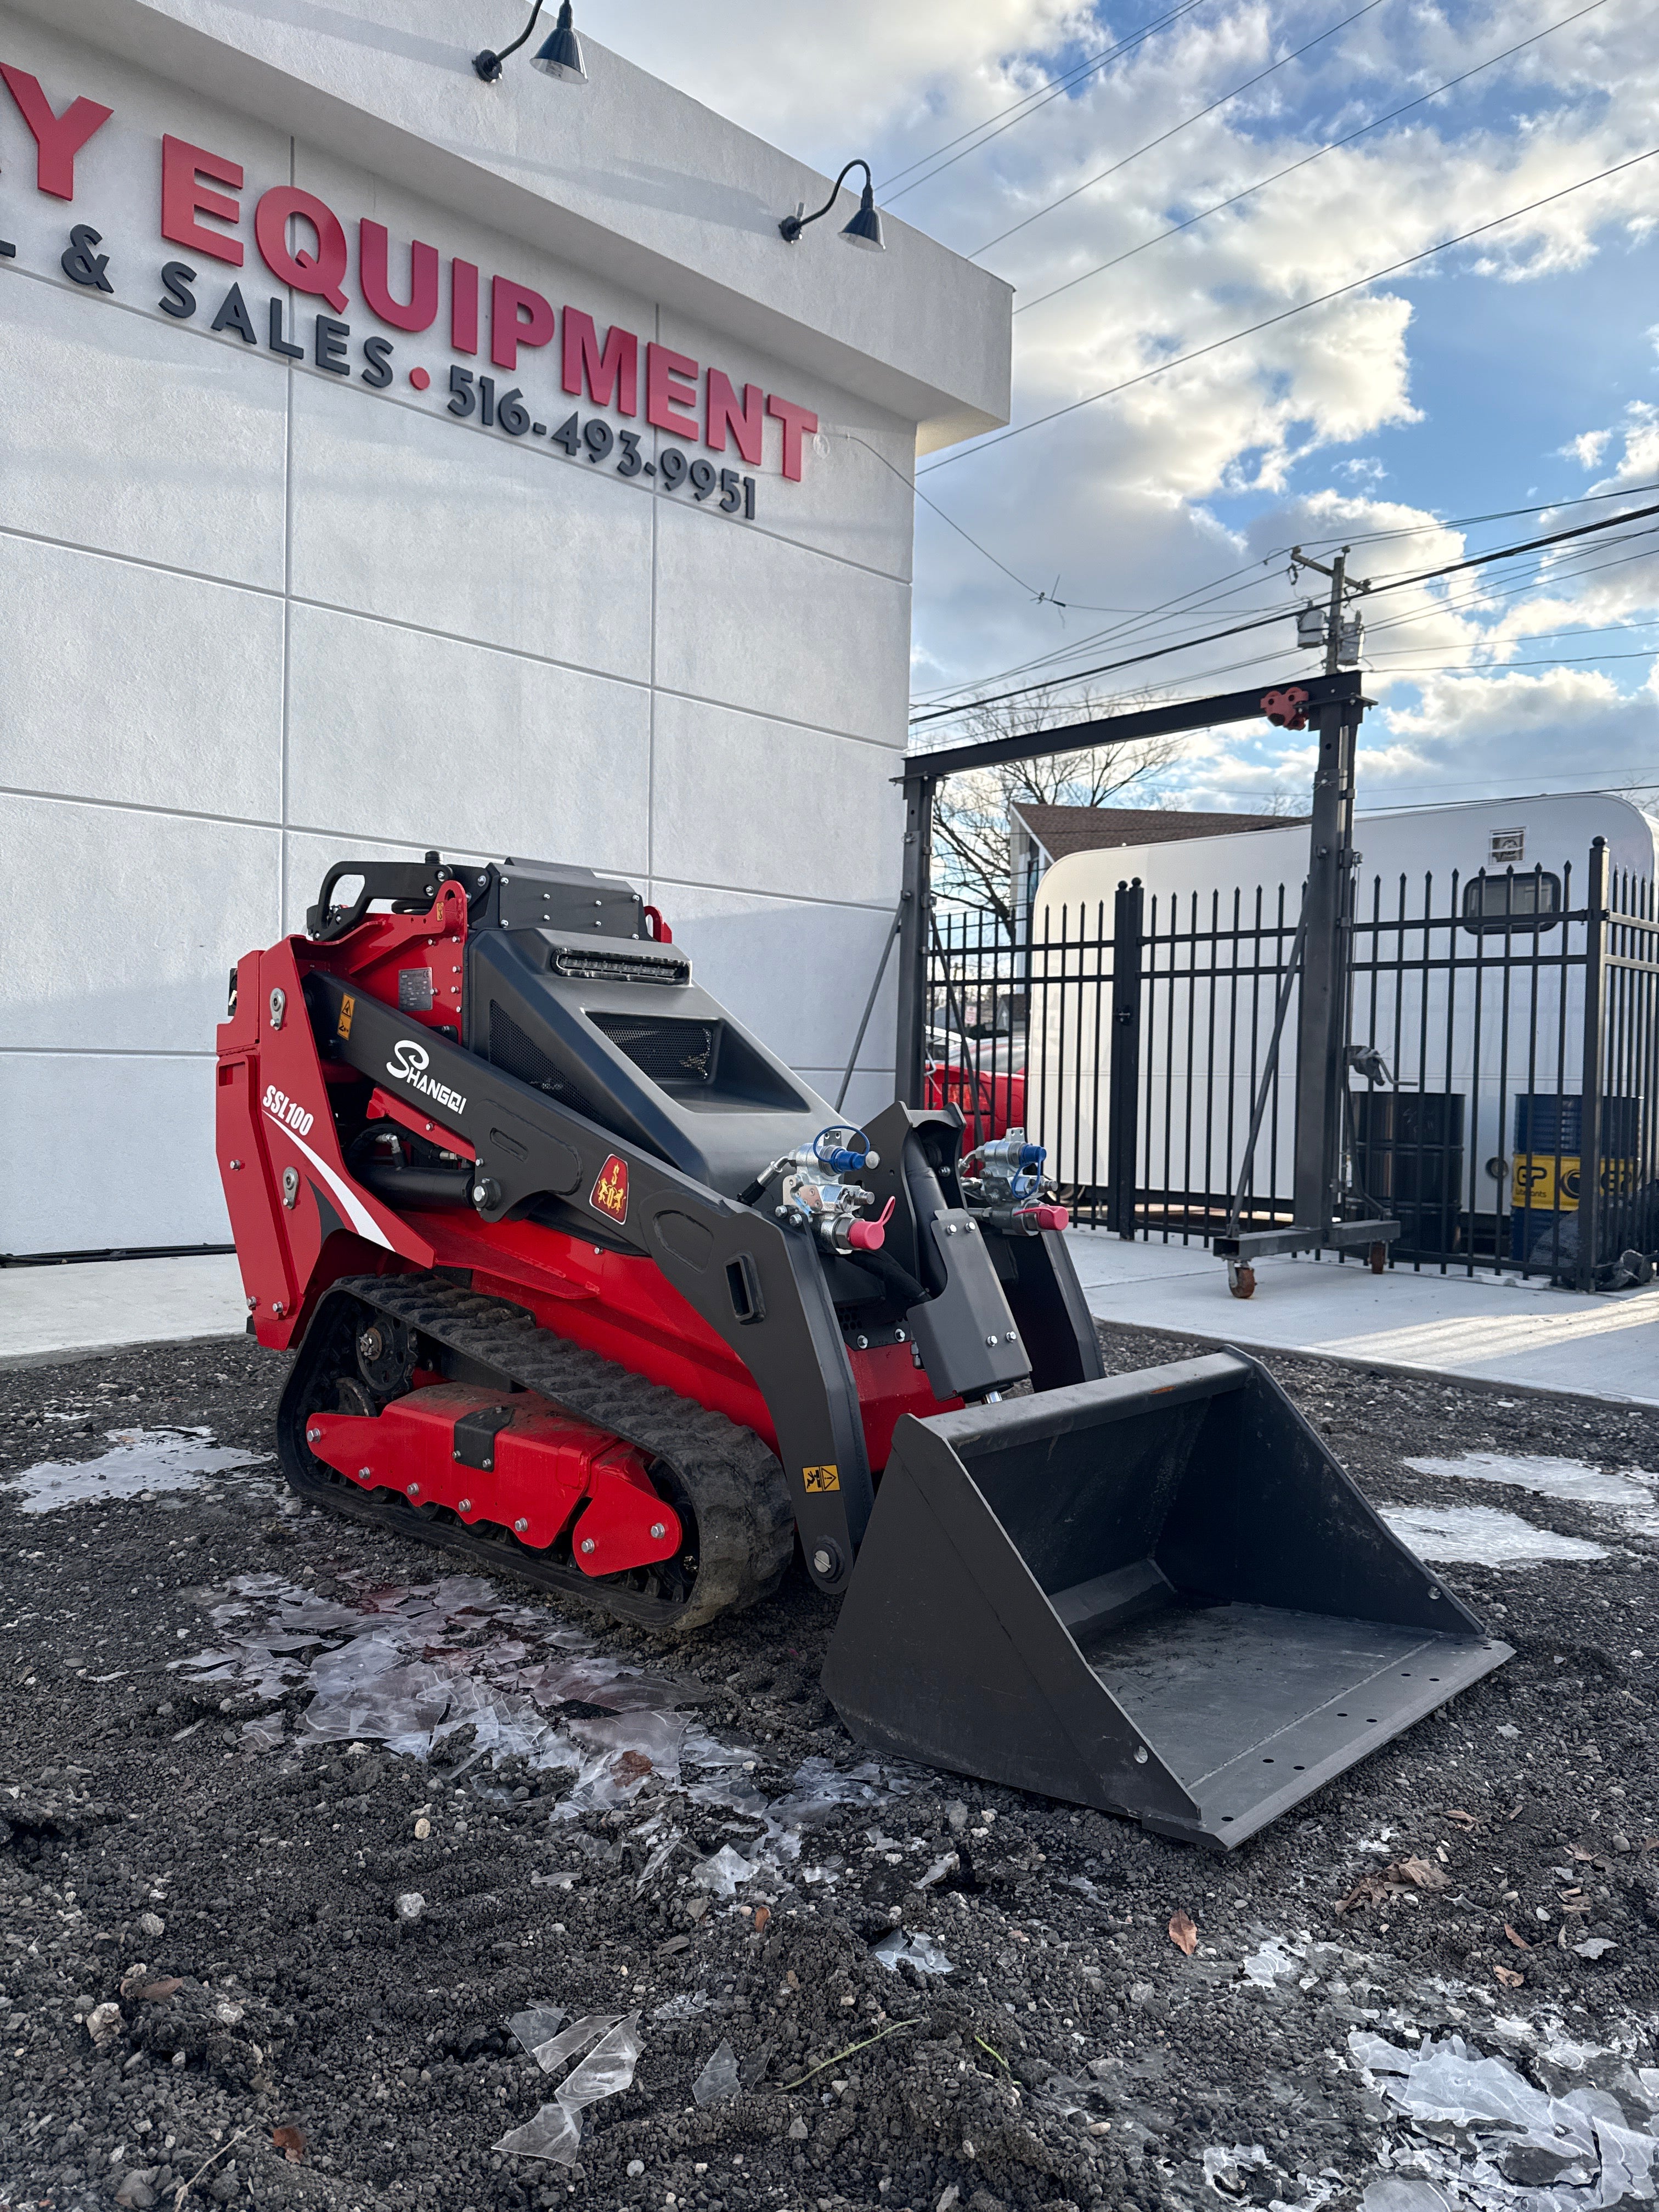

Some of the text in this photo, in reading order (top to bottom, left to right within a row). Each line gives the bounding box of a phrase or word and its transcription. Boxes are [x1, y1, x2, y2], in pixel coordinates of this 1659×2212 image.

[61, 224, 114, 293] &
[158, 261, 394, 388] SALES
[161, 133, 818, 483] EQUIPMENT
[263, 1085, 314, 1136] SSL100
[386, 1040, 467, 1114] SHANGQI
